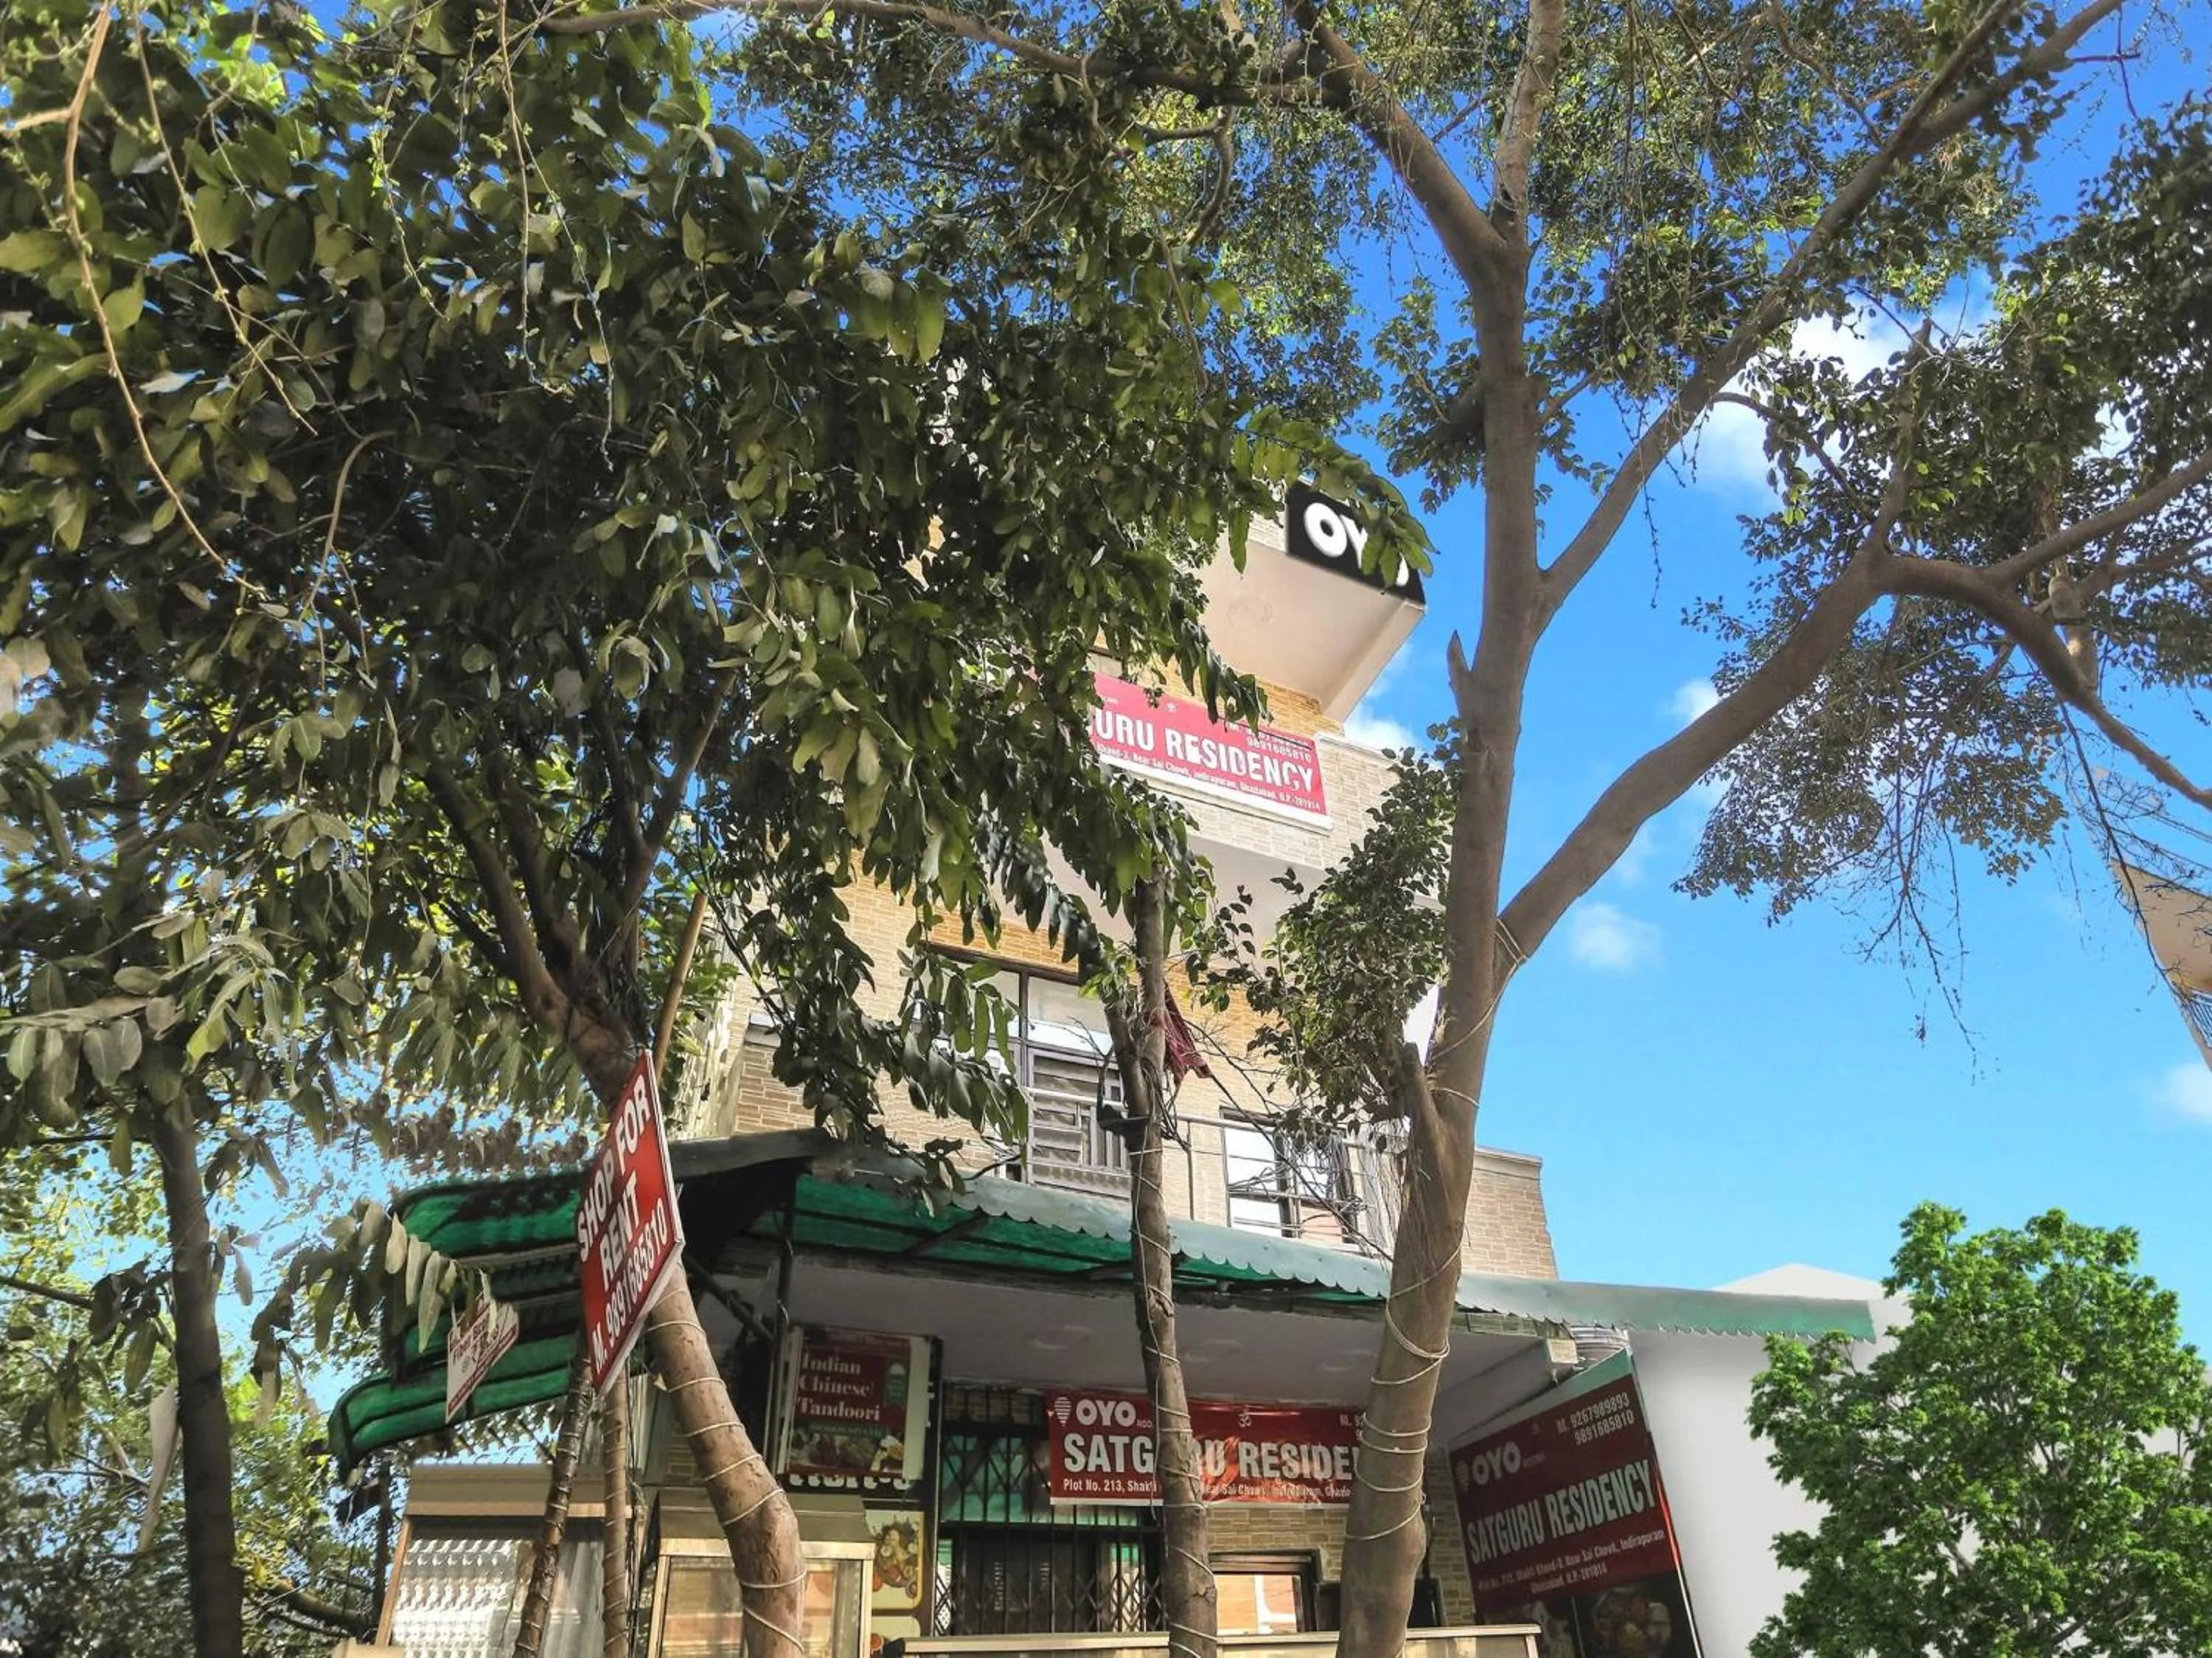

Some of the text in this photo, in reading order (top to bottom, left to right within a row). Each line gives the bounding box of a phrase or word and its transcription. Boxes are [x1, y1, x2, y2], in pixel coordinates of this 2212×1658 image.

[1304, 502, 1410, 587] OY
[1164, 726, 1313, 792] RESIDENCY
[578, 1075, 650, 1262] SHOP FOR
[599, 1171, 640, 1292] RENT
[605, 1197, 668, 1347] 9891685810
[801, 1351, 860, 1376] Indian
[797, 1397, 880, 1421] Tandoori
[1076, 1398, 1136, 1427] OYO
[1574, 1409, 1635, 1446] 9891685810
[1239, 1442, 1360, 1481] RESIDE
[1472, 1440, 1521, 1485] OYO
[1063, 1478, 1082, 1491] Plot
[1085, 1480, 1102, 1491] No.
[1104, 1480, 1125, 1494] 213,
[1467, 1459, 1655, 1564] SATGURU RESIDENCY
